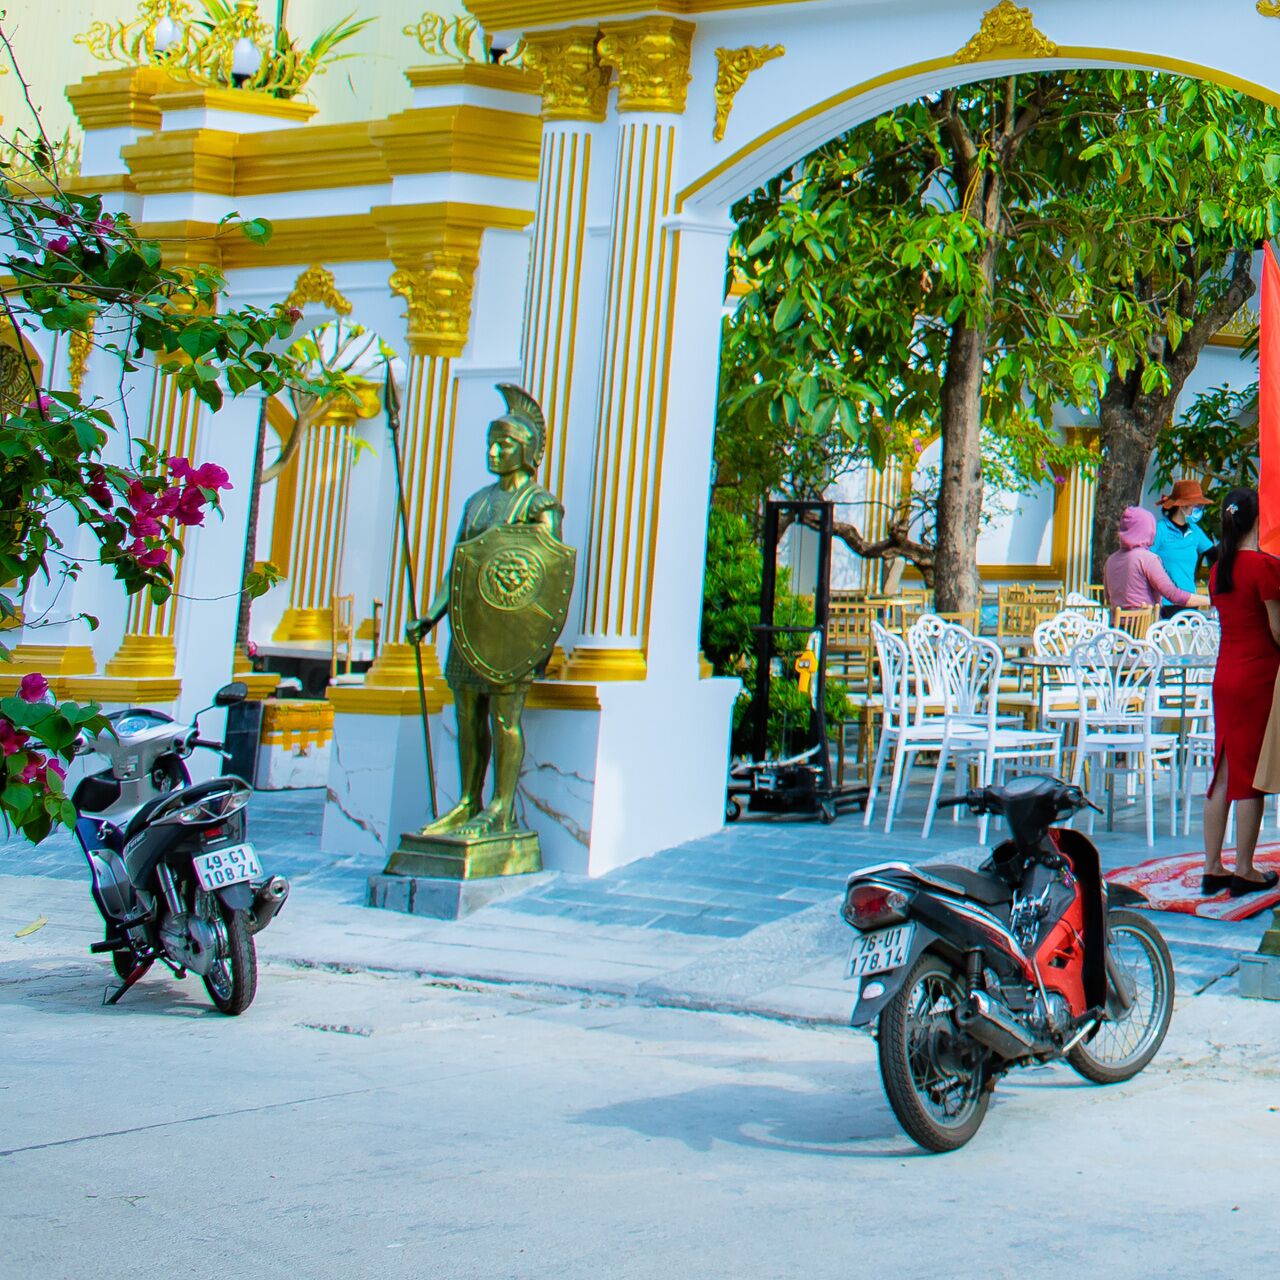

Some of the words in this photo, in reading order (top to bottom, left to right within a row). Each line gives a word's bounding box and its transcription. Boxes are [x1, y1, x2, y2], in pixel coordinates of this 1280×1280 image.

[205, 847, 247, 871] 49-G1
[204, 861, 258, 888] 108.24
[859, 927, 903, 955] 76-U1
[850, 946, 903, 977] 178.14
